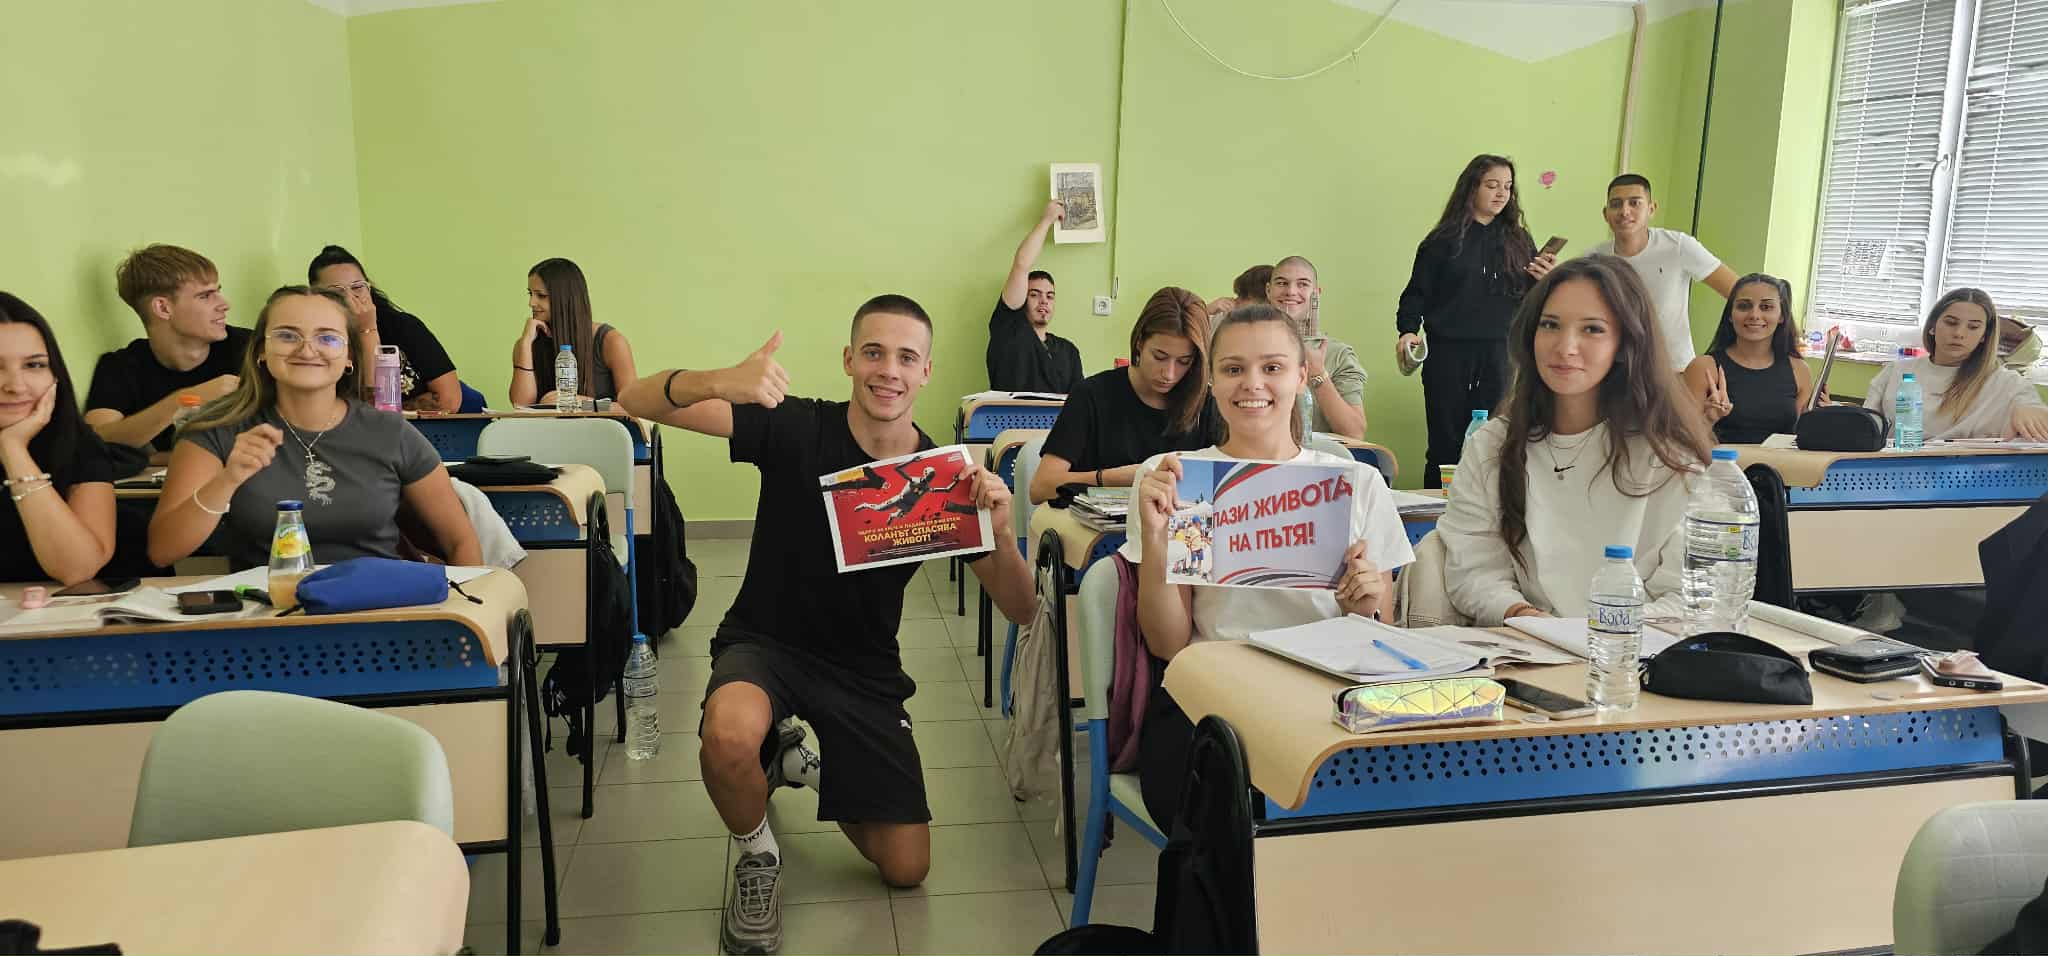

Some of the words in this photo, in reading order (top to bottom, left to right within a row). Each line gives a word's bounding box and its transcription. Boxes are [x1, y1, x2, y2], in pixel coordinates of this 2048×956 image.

[1213, 505, 1249, 528] ПАЗИ
[1253, 474, 1354, 519] ЖИВОТА
[864, 528, 910, 543] КОЛАНЪТ
[911, 523, 957, 535] СПАСЯВА
[892, 534, 931, 546] ЖИВОТ!
[1229, 533, 1251, 553] НА
[1255, 521, 1316, 550] ПЪТЯ!
